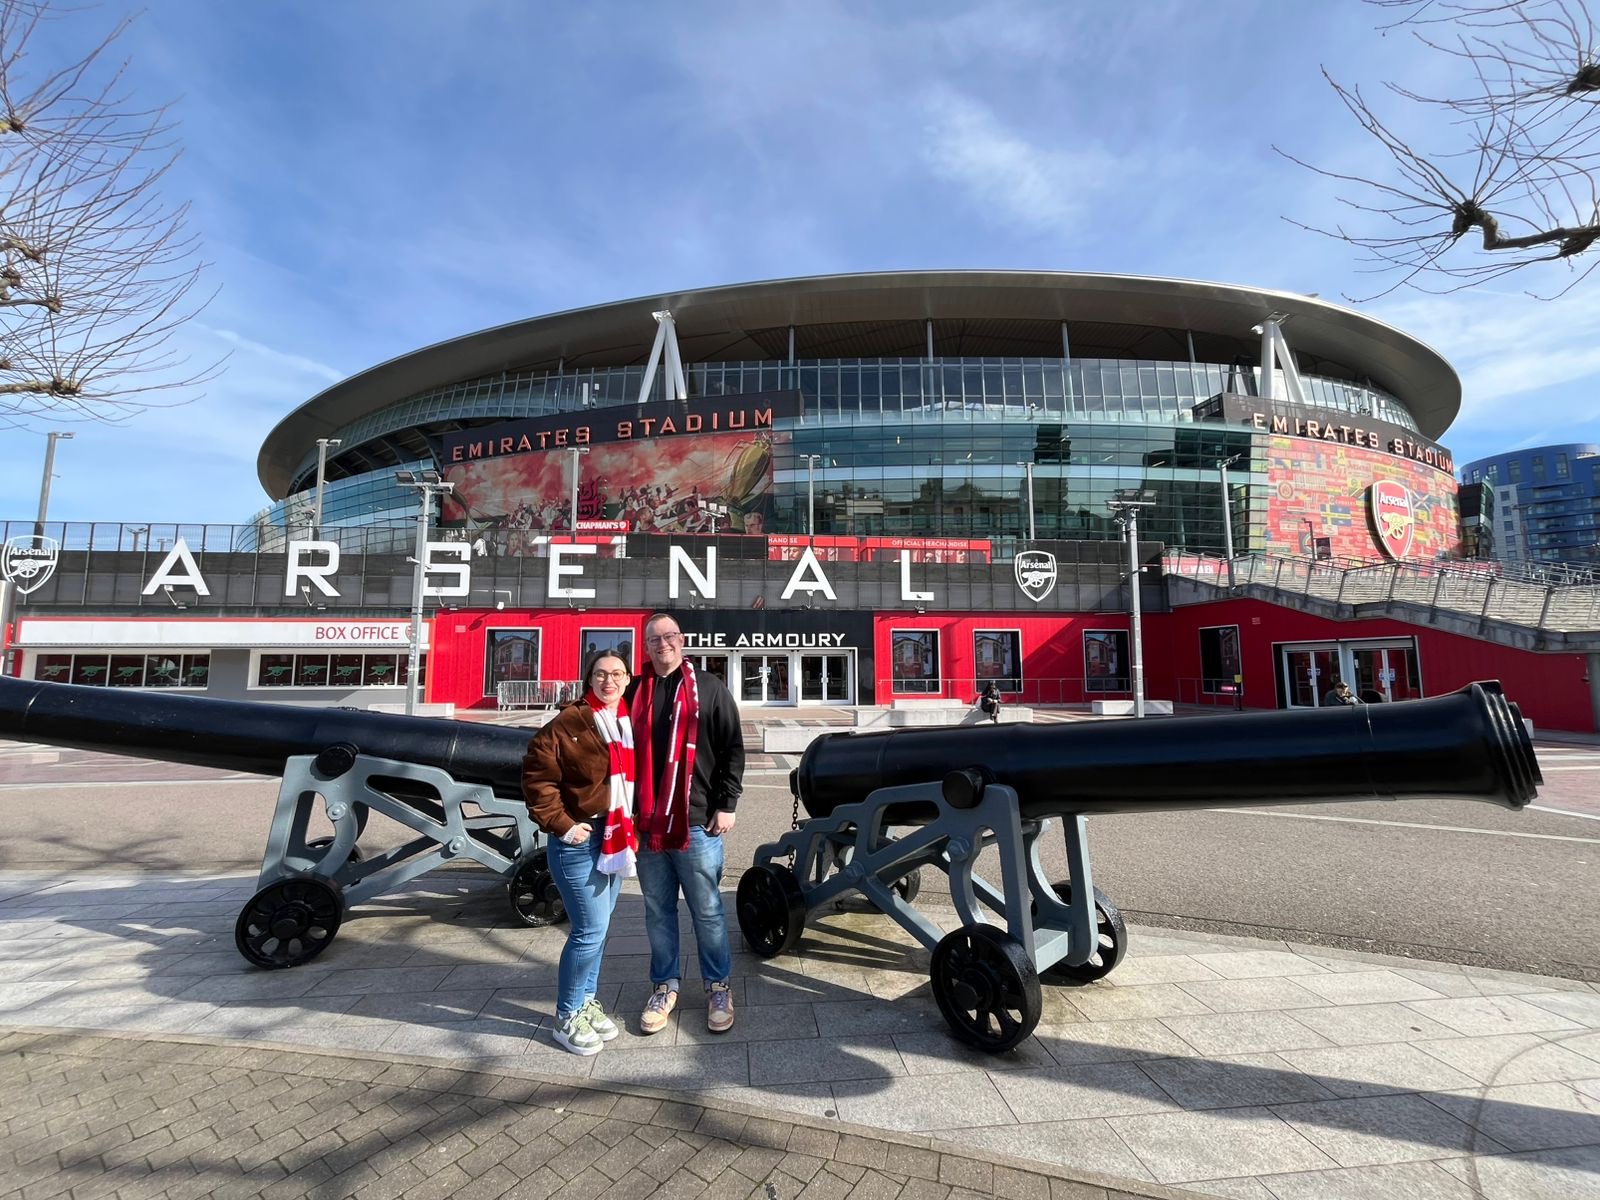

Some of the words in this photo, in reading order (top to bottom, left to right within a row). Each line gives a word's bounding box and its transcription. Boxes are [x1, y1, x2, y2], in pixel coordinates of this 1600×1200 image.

[452, 426, 590, 461] EMIRATES
[617, 408, 772, 439] STADIUM
[1253, 412, 1379, 448] EMIRATES
[1394, 438, 1453, 474] STADIUM
[576, 521, 618, 529] CHAPMAN'S
[11, 547, 51, 556] Arsenal
[141, 537, 935, 601] ARSENAL
[1020, 560, 1051, 569] Arsenal
[316, 627, 346, 640] BOX
[350, 627, 399, 640] OFFICE
[684, 633, 726, 647] THE
[735, 633, 846, 647] ARMOURY
